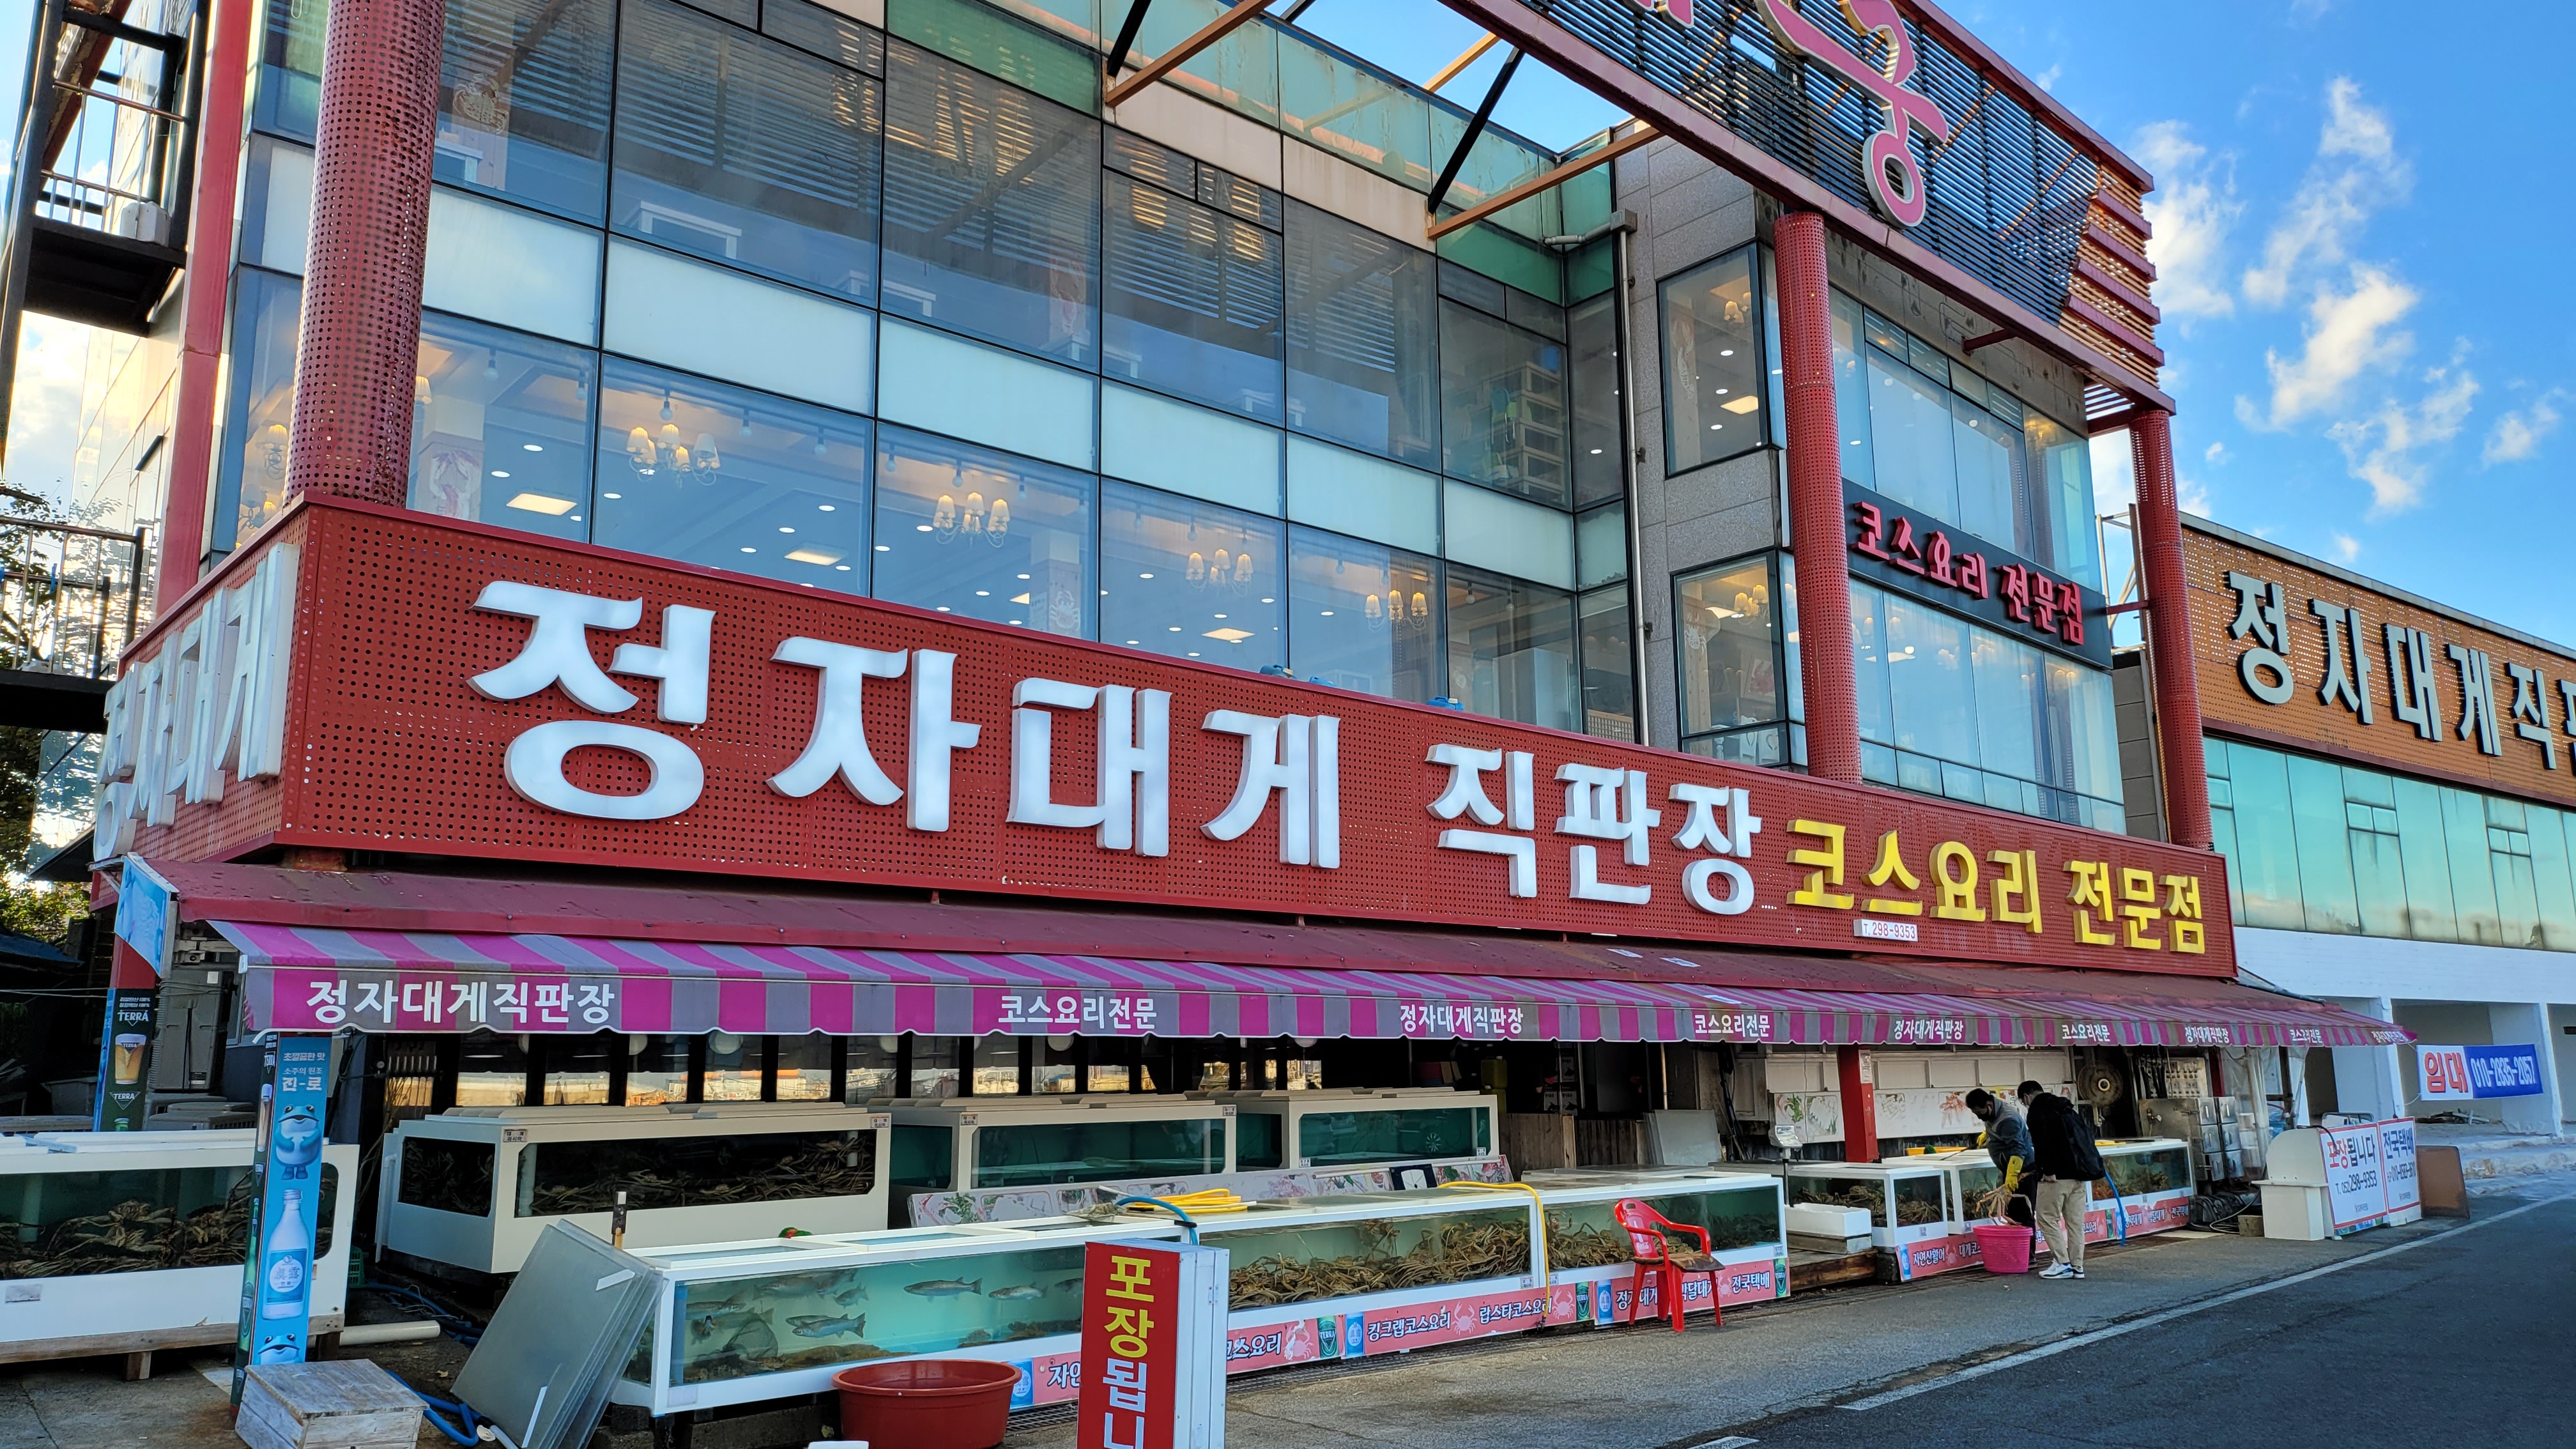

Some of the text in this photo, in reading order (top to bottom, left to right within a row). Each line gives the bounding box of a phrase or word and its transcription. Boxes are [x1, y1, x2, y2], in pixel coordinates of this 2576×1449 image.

[1851, 500, 2084, 646] 코스요리 전문점
[466, 580, 2205, 954] 정자대게 직판장 코스요리 전문점
[1873, 922, 1915, 939] 298-9353
[307, 979, 615, 1023] 정자대게직판장
[998, 995, 1157, 1030] 코스요리전문
[117, 1011, 149, 1022] TERRA
[1400, 1004, 1524, 1034] 정자대게직판장
[1695, 1013, 1770, 1038] 코스요리전문
[1894, 1019, 1964, 1041] 정자대게직판장
[2062, 1023, 2110, 1042] 코스요리전문
[2184, 1026, 2230, 1043] 정자대게직판장
[282, 1067, 307, 1075] 소주의
[2424, 1052, 2469, 1093] 임대
[2327, 1133, 2376, 1169] 포장됩니다
[2382, 1126, 2415, 1160] 전국택배
[1912, 1246, 1946, 1268] 자연산활어
[1731, 1270, 1770, 1294] 전국택배
[1319, 1330, 1336, 1339] TERRA
[1367, 1311, 1451, 1342] 킹크랩코스요리
